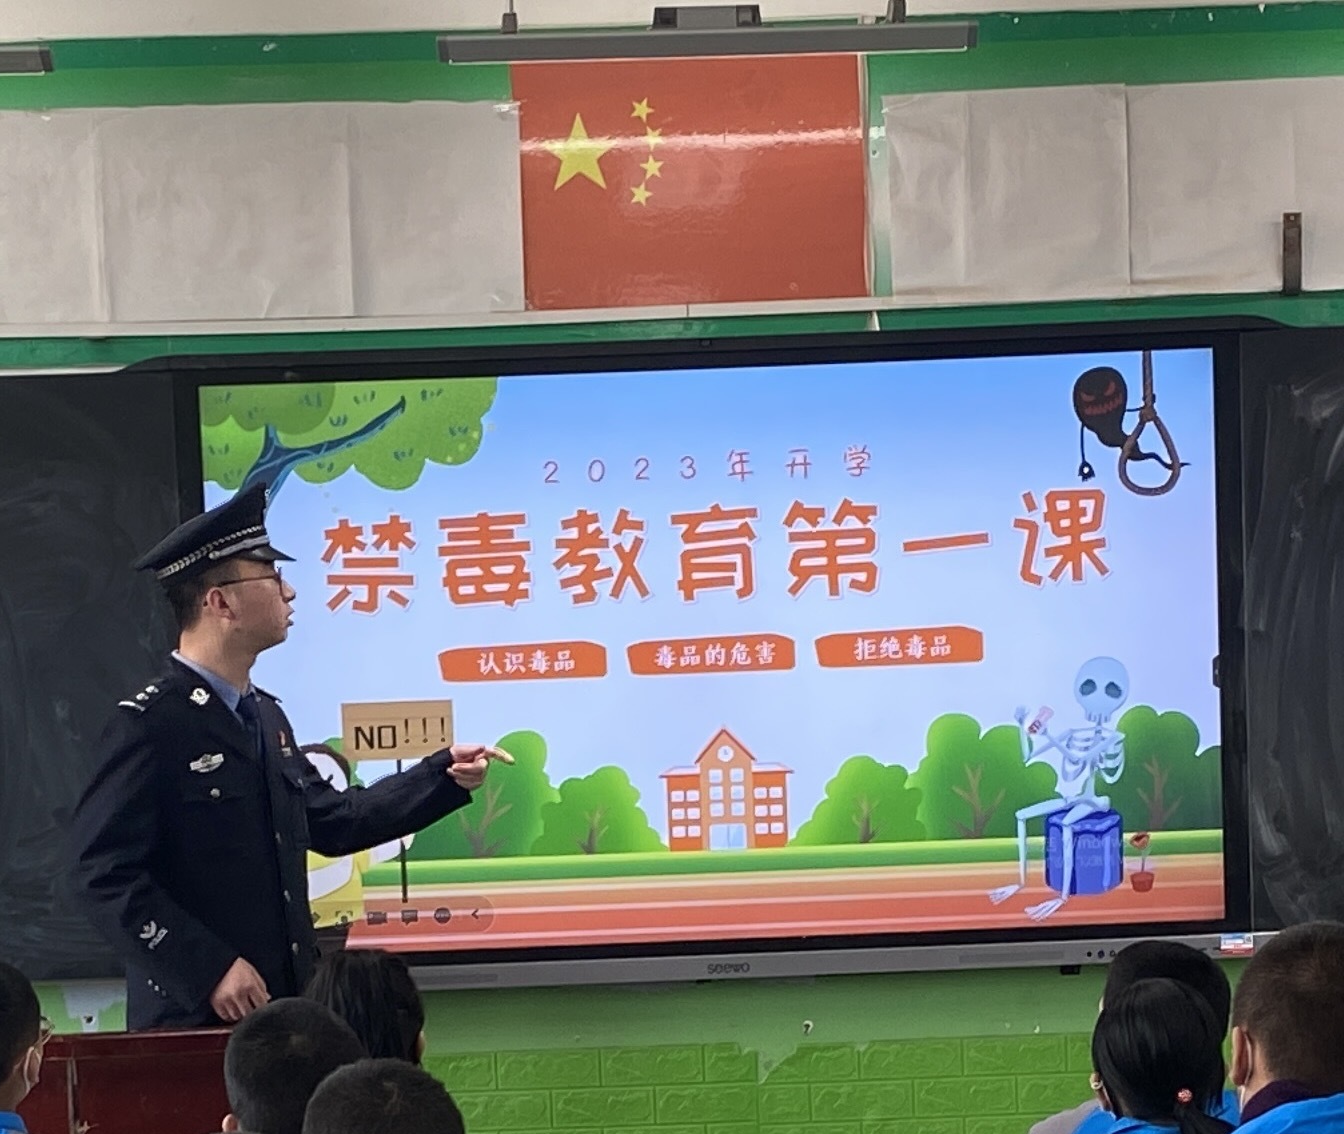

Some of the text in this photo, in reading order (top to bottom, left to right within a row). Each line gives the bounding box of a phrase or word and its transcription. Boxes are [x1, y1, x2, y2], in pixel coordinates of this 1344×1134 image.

[544, 444, 871, 484] 2023年开学
[320, 489, 1109, 613] 禁毒教育第一课
[476, 634, 953, 675] 认识毒品 毒品的危害 拒绝毒品
[354, 716, 446, 751] NO!!!
